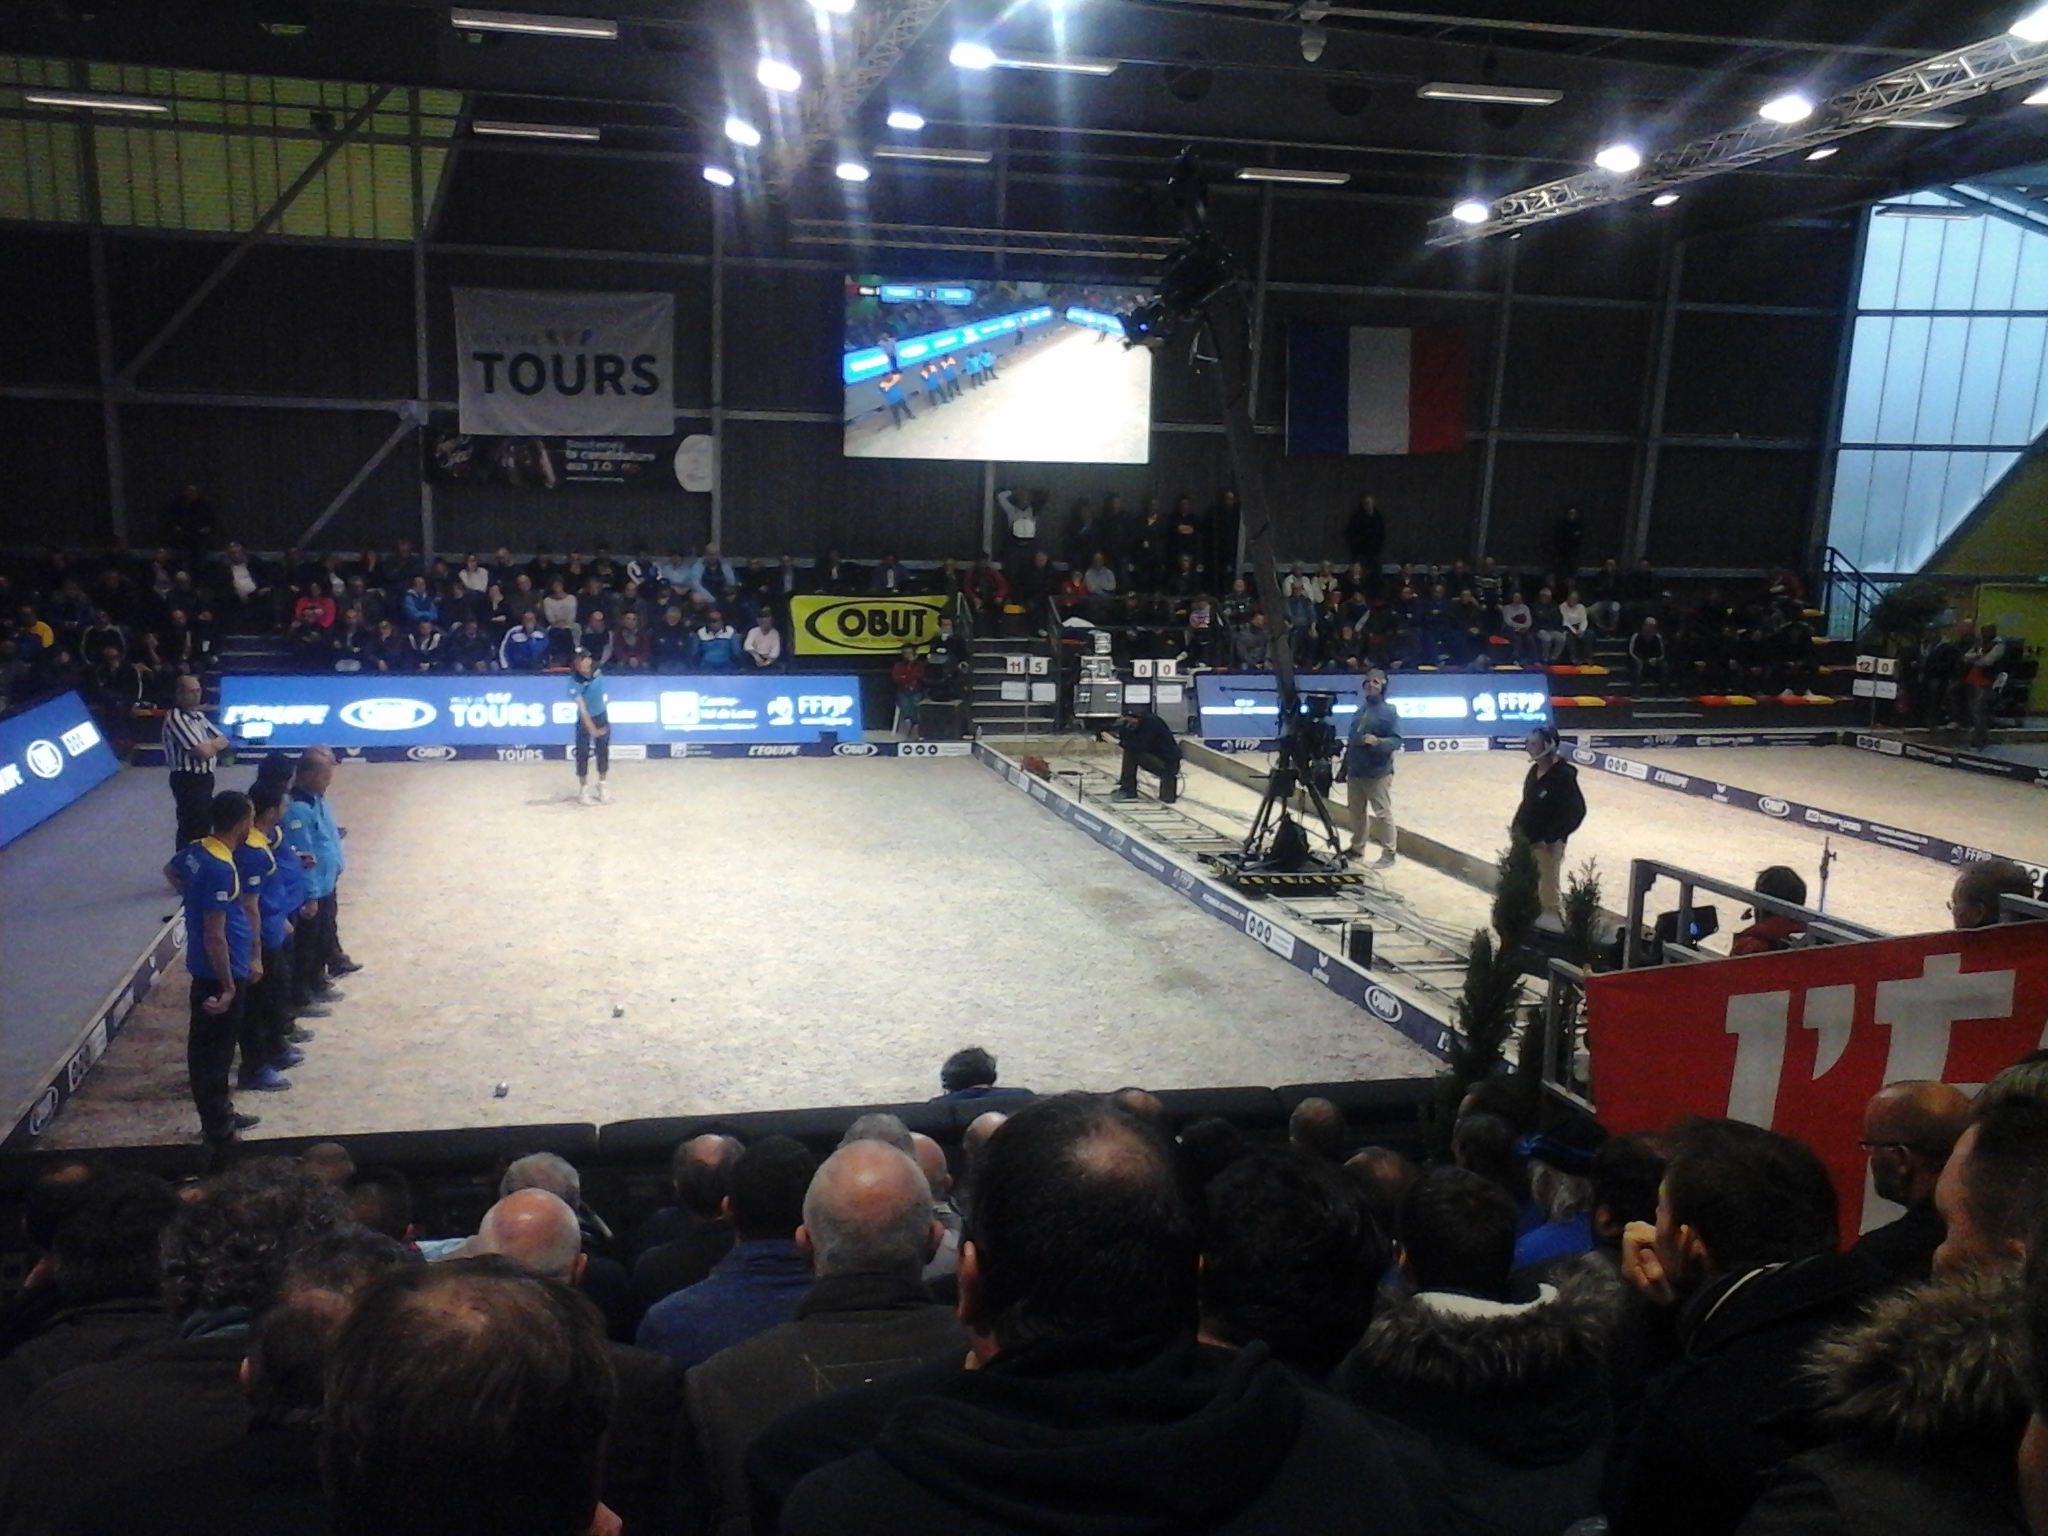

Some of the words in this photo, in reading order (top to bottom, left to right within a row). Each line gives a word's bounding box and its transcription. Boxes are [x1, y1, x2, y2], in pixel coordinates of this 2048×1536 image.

[472, 351, 660, 396] TOURS
[837, 608, 927, 637] OBUT
[1009, 662, 1022, 673] 11
[1034, 662, 1043, 673] 5
[1139, 664, 1147, 674] 0
[1163, 663, 1171, 674] 0
[449, 704, 546, 727] TOURS
[496, 749, 544, 761] TOURS
